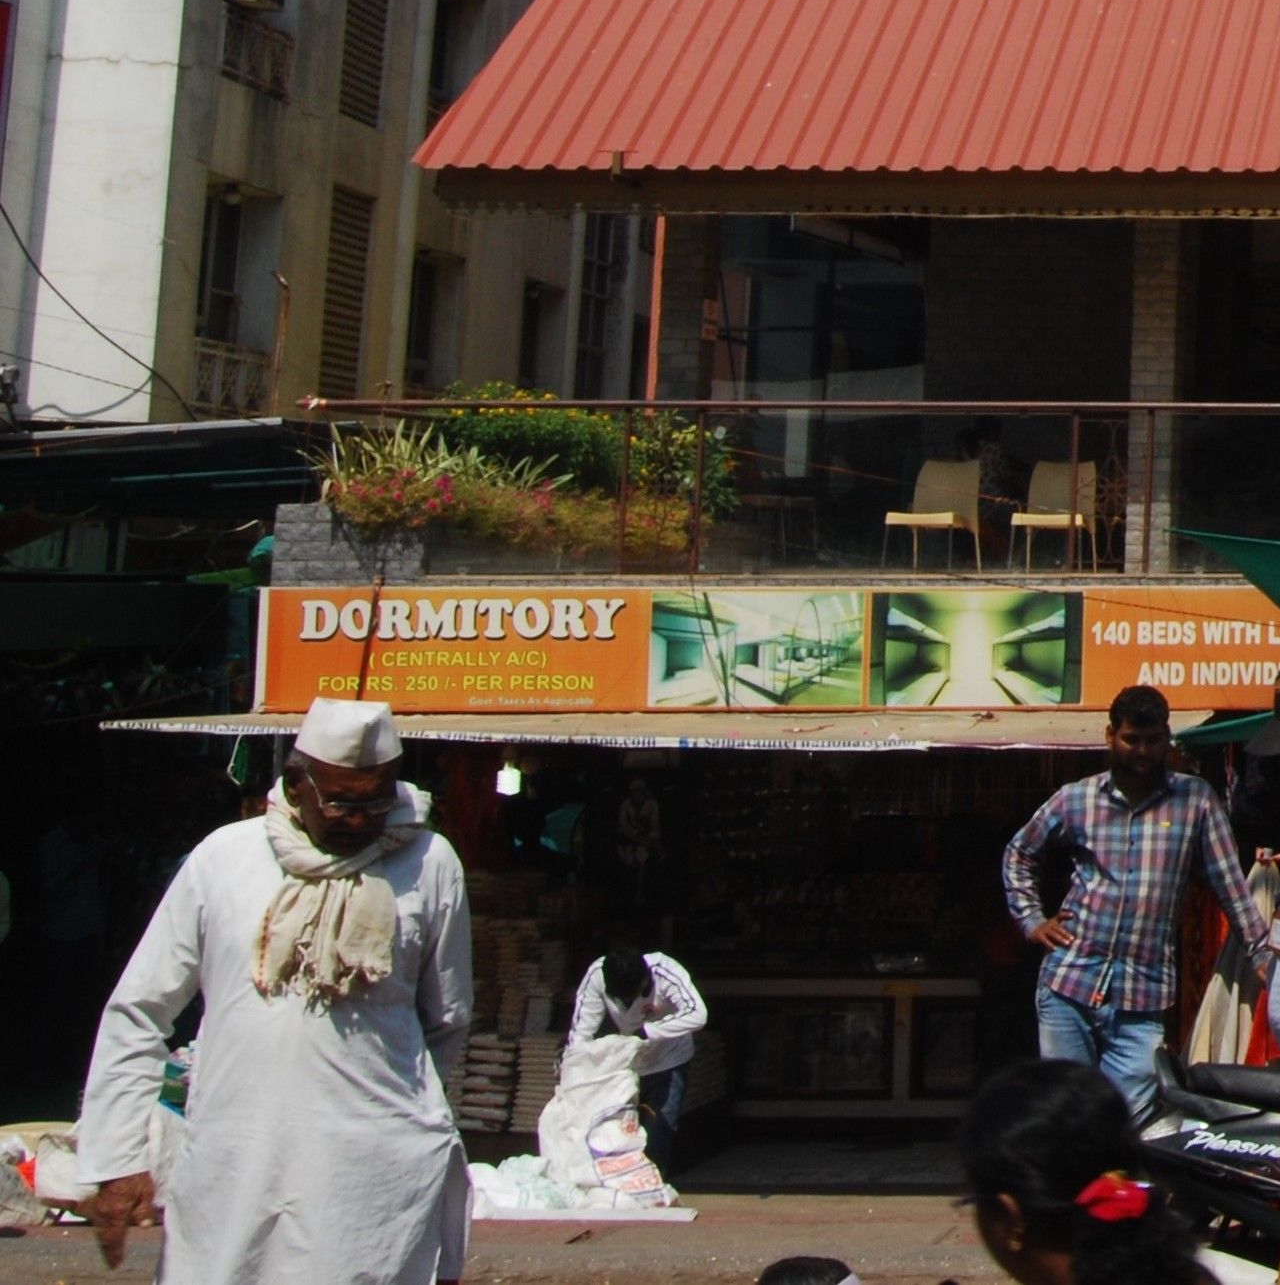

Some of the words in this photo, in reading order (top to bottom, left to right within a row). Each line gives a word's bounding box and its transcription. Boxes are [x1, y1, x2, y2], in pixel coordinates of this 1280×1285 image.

[299, 597, 626, 643] DORMITORY
[1091, 620, 1131, 646] 140
[1137, 620, 1197, 646] BEDS
[1202, 620, 1262, 645] WITH
[318, 675, 359, 692] FOR
[367, 675, 398, 692] RS.
[405, 675, 438, 691] 250
[463, 675, 503, 691] PER
[509, 674, 595, 691] PERSON
[1138, 661, 1186, 686] AND
[1192, 661, 1280, 686] INDIVID
